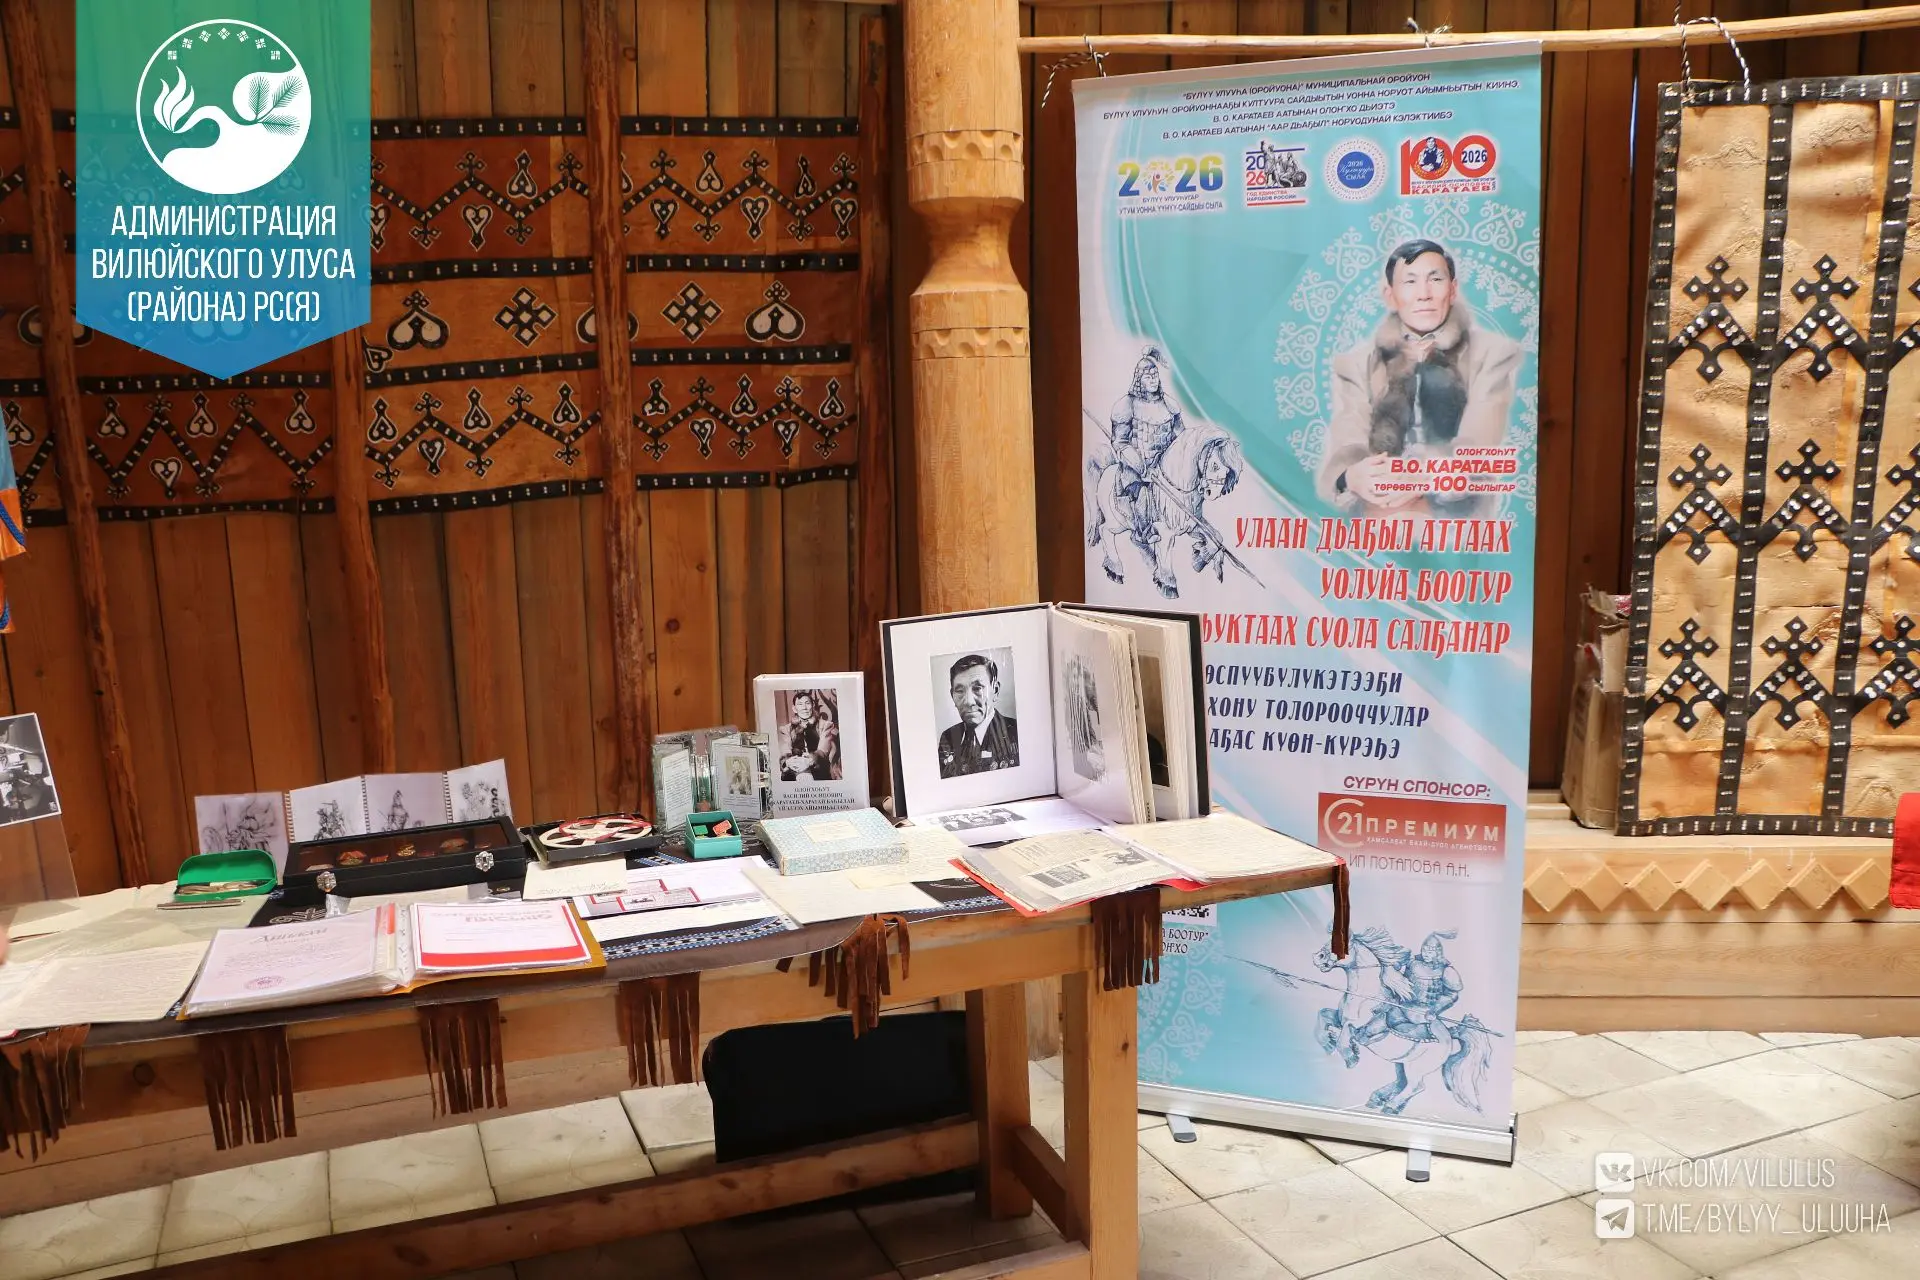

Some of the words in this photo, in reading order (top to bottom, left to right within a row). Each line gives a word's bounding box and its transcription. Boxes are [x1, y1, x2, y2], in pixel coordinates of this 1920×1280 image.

[1306, 76, 1386, 90] МУНИЦИПАЛЬНАЙ
[1387, 73, 1431, 84] ОРОЙУОН
[1242, 98, 1286, 109] КУЛТУУРА
[1287, 92, 1344, 106] САЙДЫЫТЫН
[1346, 89, 1376, 100] УОННА
[1377, 87, 1414, 98] НОРУОТ
[1415, 82, 1482, 95] АЙЫМНЬЫТЫН
[1212, 115, 1221, 123] В.
[1222, 114, 1231, 122] О.
[1232, 111, 1275, 122] КАРАТАЕВ
[1275, 106, 1318, 119] ААТЫНАН
[1359, 102, 1396, 113] ДЬИЭТЭ
[1163, 131, 1171, 140] В.
[1172, 130, 1180, 139] О.
[1181, 127, 1223, 138] КАРАТАЕВ
[1224, 124, 1266, 136] ААТЫНАН
[1332, 114, 1392, 127] НОРУОДУНАЙ
[1393, 111, 1454, 123] КЭЛЭКТИИБЭ
[1246, 155, 1266, 171] 20
[1461, 149, 1488, 164] 2026
[1246, 170, 1266, 186] 26
[1412, 185, 1490, 195] КАРАТАЕВ
[1136, 205, 1156, 214] УОННА
[1205, 201, 1223, 209] СЫЛА
[1391, 459, 1423, 474] В.О.
[1426, 459, 1516, 474] КАРАТАЕВ
[1433, 475, 1467, 492] 100
[1468, 484, 1516, 493] СЫЛЫГАР
[1235, 517, 1308, 549] УЛААН
[1420, 519, 1512, 552] АТТААХ
[1320, 562, 1409, 601] УОЛУЙА
[1416, 570, 1512, 604] БООТУР
[1306, 616, 1379, 649] СУОЛА
[1266, 699, 1430, 728] ТОЛОРООЧЧУЛАР
[1403, 779, 1492, 798] СПОНСОР:
[1366, 817, 1499, 842] ПРЕМИУМ
[1350, 855, 1366, 869] ИП
[1370, 856, 1442, 875] ПОТАПОВА
[1446, 863, 1470, 878] А.Н.
